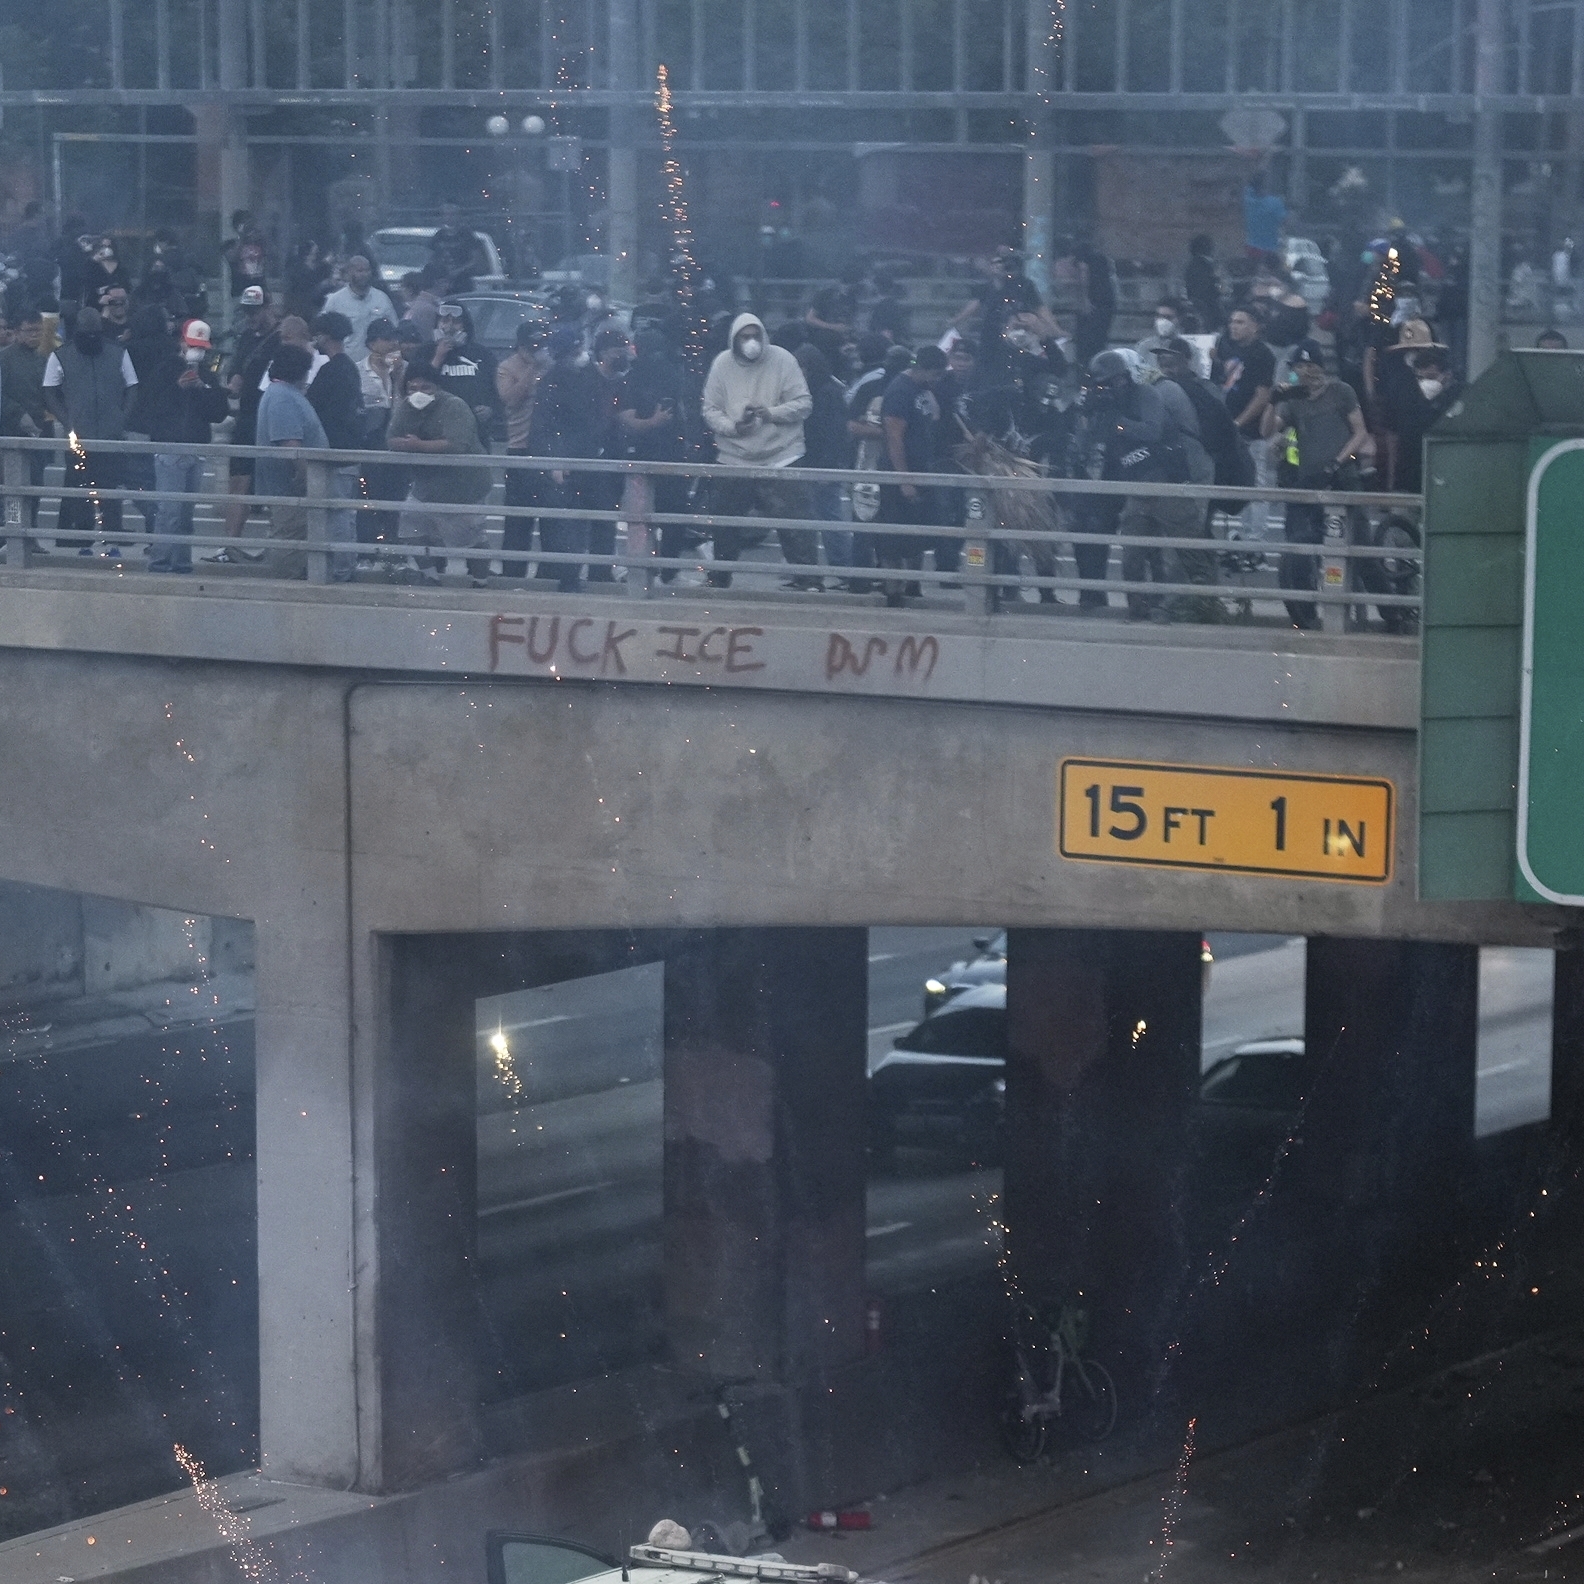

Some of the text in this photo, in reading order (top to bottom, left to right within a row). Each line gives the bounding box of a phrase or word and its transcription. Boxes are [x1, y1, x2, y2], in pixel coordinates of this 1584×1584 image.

[441, 364, 476, 376] PUMA
[488, 614, 637, 673] FUCK
[656, 624, 766, 673] ICE
[1085, 784, 1365, 858] 15 FT 1 IN
